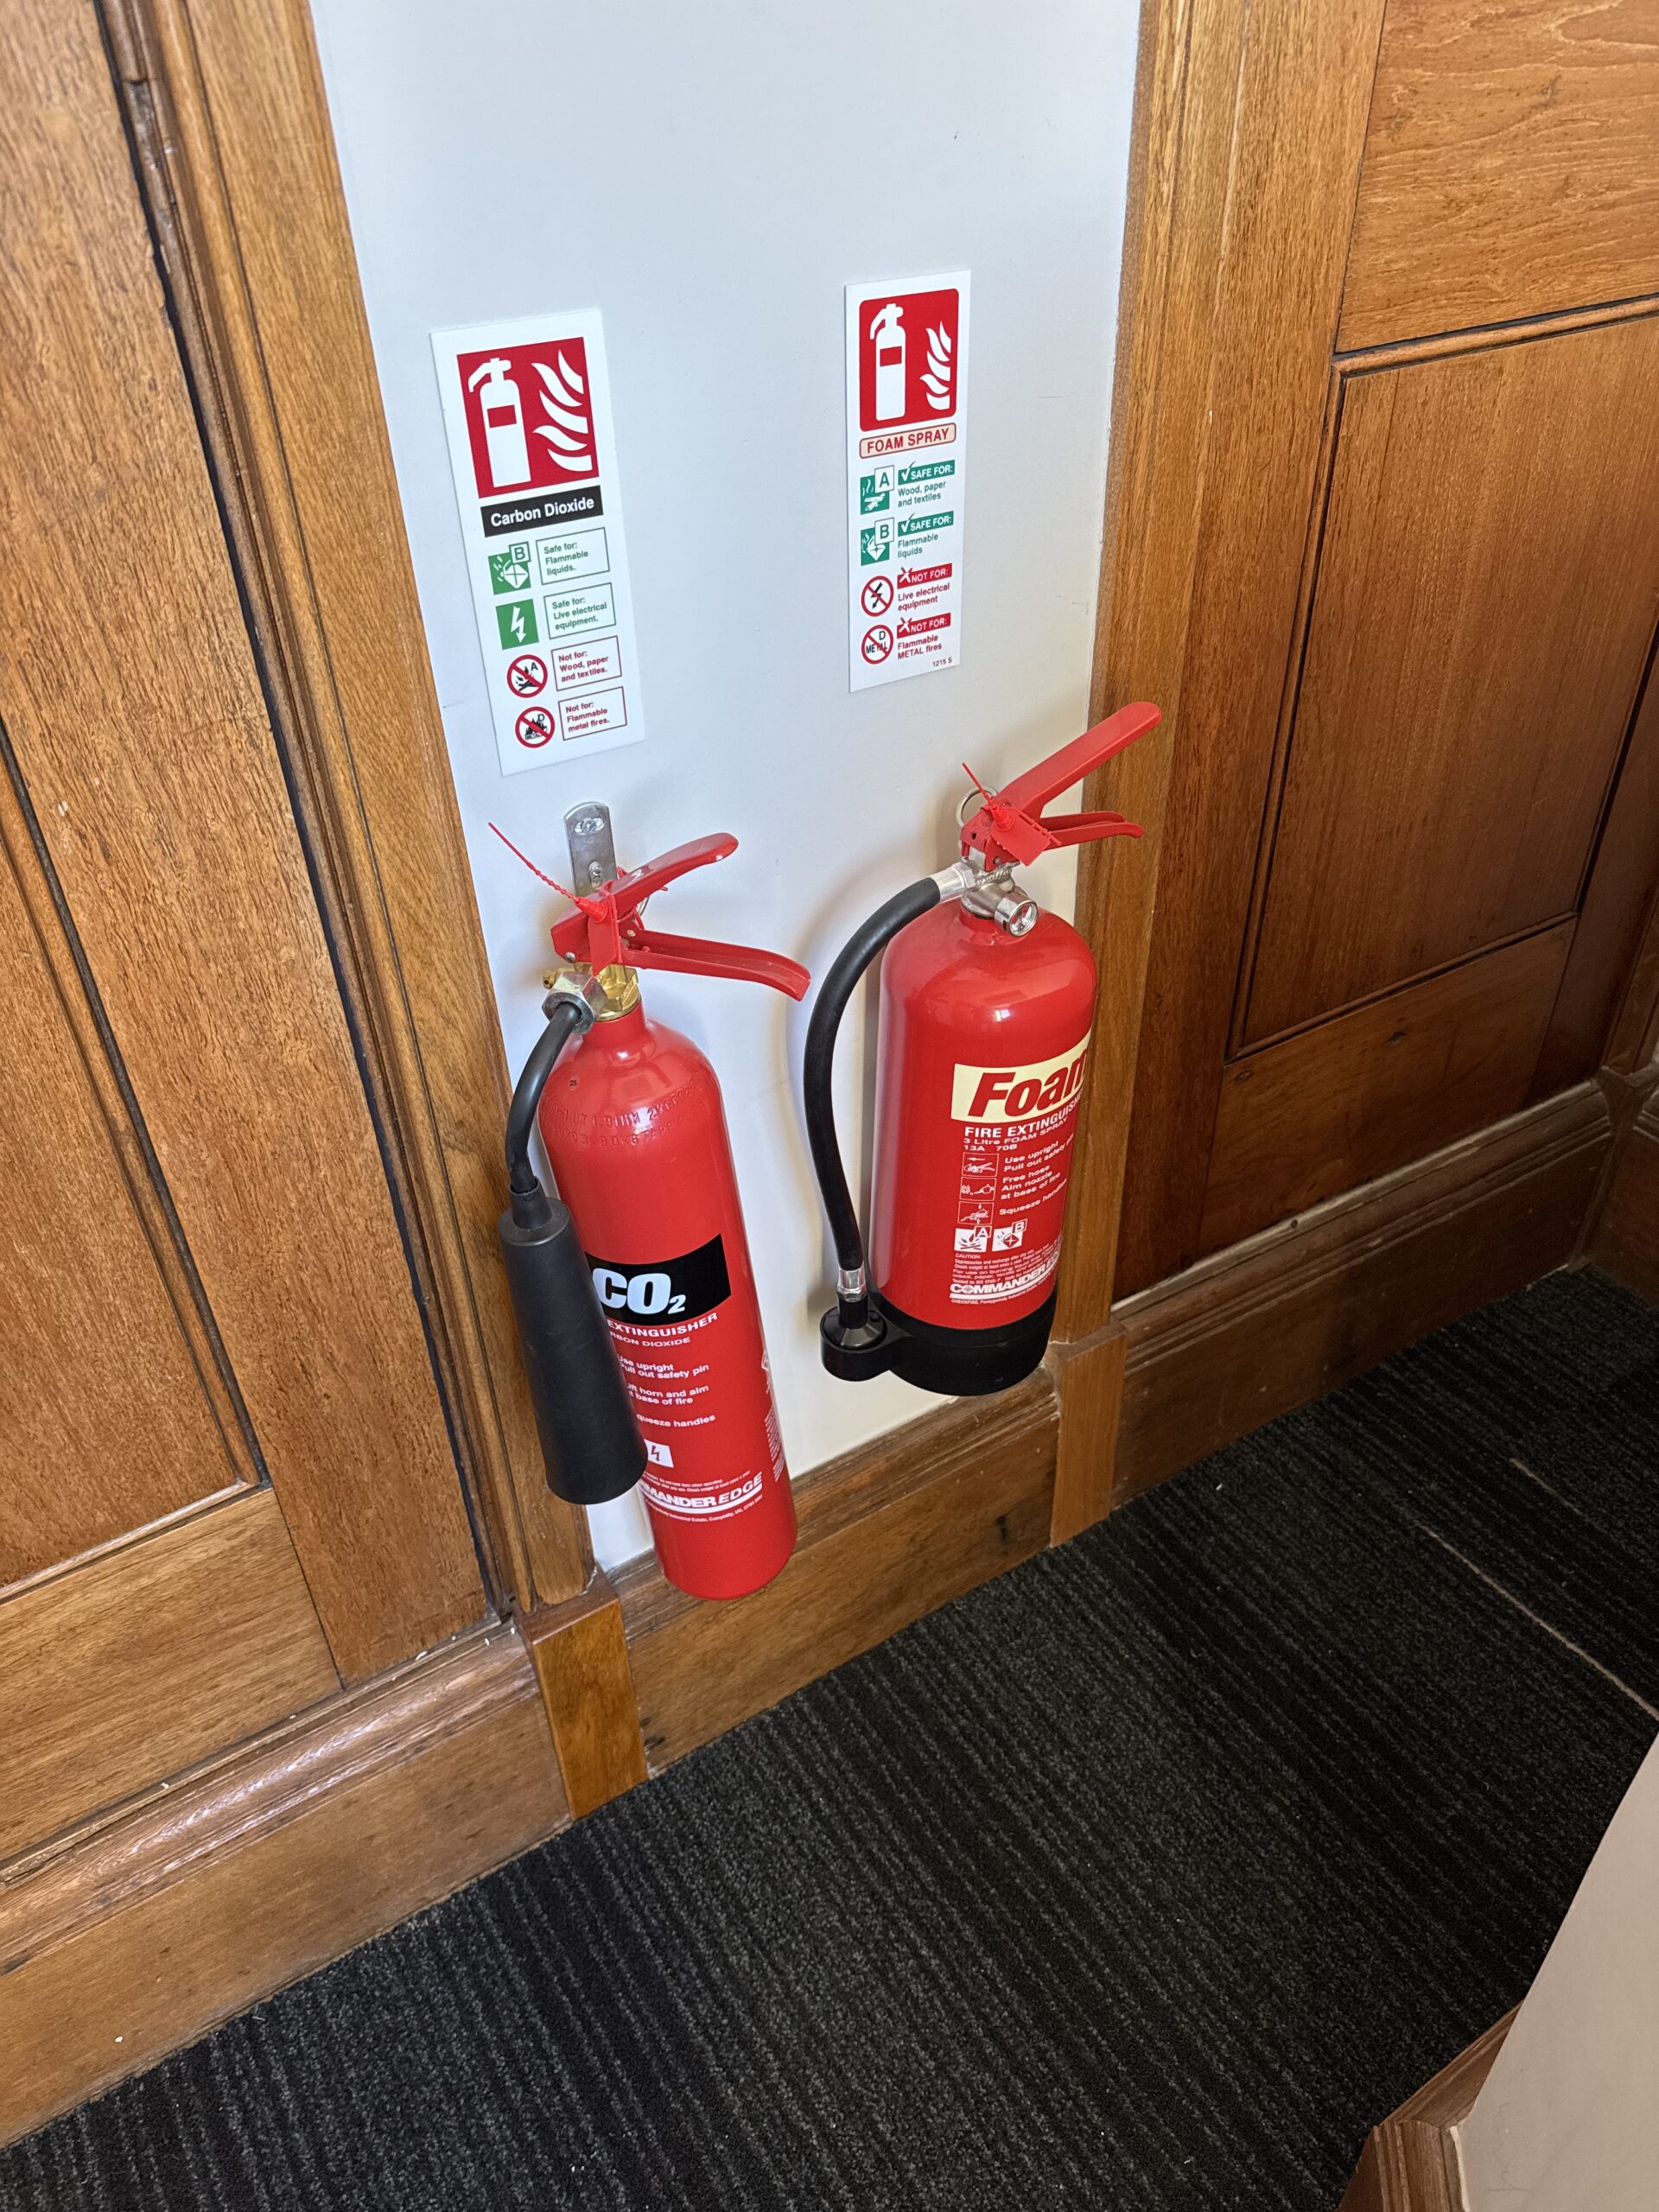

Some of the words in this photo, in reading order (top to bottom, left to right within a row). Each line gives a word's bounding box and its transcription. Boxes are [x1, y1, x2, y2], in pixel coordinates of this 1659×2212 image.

[867, 436, 904, 454] FOAM
[907, 428, 949, 447] SPRAY
[879, 472, 890, 488] A
[911, 468, 931, 480] SAFE
[933, 465, 953, 475] FOR:
[898, 486, 922, 497] Wood,
[924, 481, 946, 493] paper
[898, 499, 912, 507] and
[914, 493, 941, 504] textiles
[491, 508, 541, 527] Carbon
[544, 497, 594, 518] Dioxide
[910, 519, 931, 531] SAFE
[933, 516, 952, 526] FOR:
[880, 524, 889, 539] B
[898, 533, 938, 549] Flammable
[513, 546, 525, 561] B
[543, 544, 562, 555] Safe
[545, 550, 589, 564] Flammable
[898, 547, 923, 559] liquids
[547, 564, 575, 576] liquids.
[912, 573, 928, 583] NOT
[931, 569, 948, 579] FOR:
[899, 593, 913, 601] Live
[916, 582, 950, 597] electrical
[552, 601, 569, 610] Safe
[572, 597, 586, 606] for:
[554, 611, 569, 620] Live
[572, 602, 607, 616] electrical
[898, 595, 938, 612] equipment
[555, 615, 598, 630] equipment.
[911, 622, 927, 632] NOT
[929, 618, 947, 628] FOR:
[879, 630, 886, 640] D
[898, 635, 938, 651] Flammable
[898, 647, 924, 659] METAL
[925, 643, 942, 653] fires
[531, 662, 538, 671] A
[560, 661, 585, 672] Wood,
[587, 656, 608, 667] paper
[932, 658, 946, 667] 1215
[561, 673, 575, 682] and
[577, 667, 607, 678] textiles.
[566, 704, 580, 714] Not
[567, 708, 607, 722] Flammable
[569, 721, 588, 733] metal
[590, 717, 610, 728] fires.
[968, 1048, 1087, 1117] Foam
[964, 1127, 1001, 1138] FIRE
[1004, 1133, 1037, 1143] FOAM
[1039, 1116, 1067, 1135] SPRAY
[1004, 1164, 1024, 1173] Pull
[1027, 1157, 1042, 1167] out
[1044, 1142, 1065, 1161] safety
[1005, 1155, 1025, 1164] Use
[1027, 1141, 1058, 1159] upright
[1001, 1183, 1022, 1192] Aim
[1025, 1171, 1052, 1185] nozzle
[1002, 1175, 1026, 1184] Free
[1028, 1165, 1050, 1179] hose
[1013, 1186, 1037, 1198] base
[1039, 1179, 1048, 1190] of
[1049, 1172, 1061, 1182] fire
[999, 1199, 1040, 1215] Squeeze
[977, 1227, 988, 1237] A
[1014, 1221, 1025, 1232] B
[950, 1264, 1046, 1294] COMMANDER
[607, 1313, 717, 1338] EXTINGUISHER
[610, 1332, 639, 1345] RBON
[642, 1337, 691, 1347] DIOXIDE
[637, 1363, 674, 1372] upright
[658, 1370, 690, 1379] safety
[693, 1364, 709, 1376] pin
[628, 1383, 638, 1392] ift
[639, 1387, 664, 1398] horn
[666, 1389, 686, 1398] and
[690, 1385, 709, 1395] aim
[636, 1392, 659, 1404] base
[636, 1414, 671, 1427] queeze
[673, 1414, 715, 1427] handles
[718, 1471, 762, 1504] EDGE
